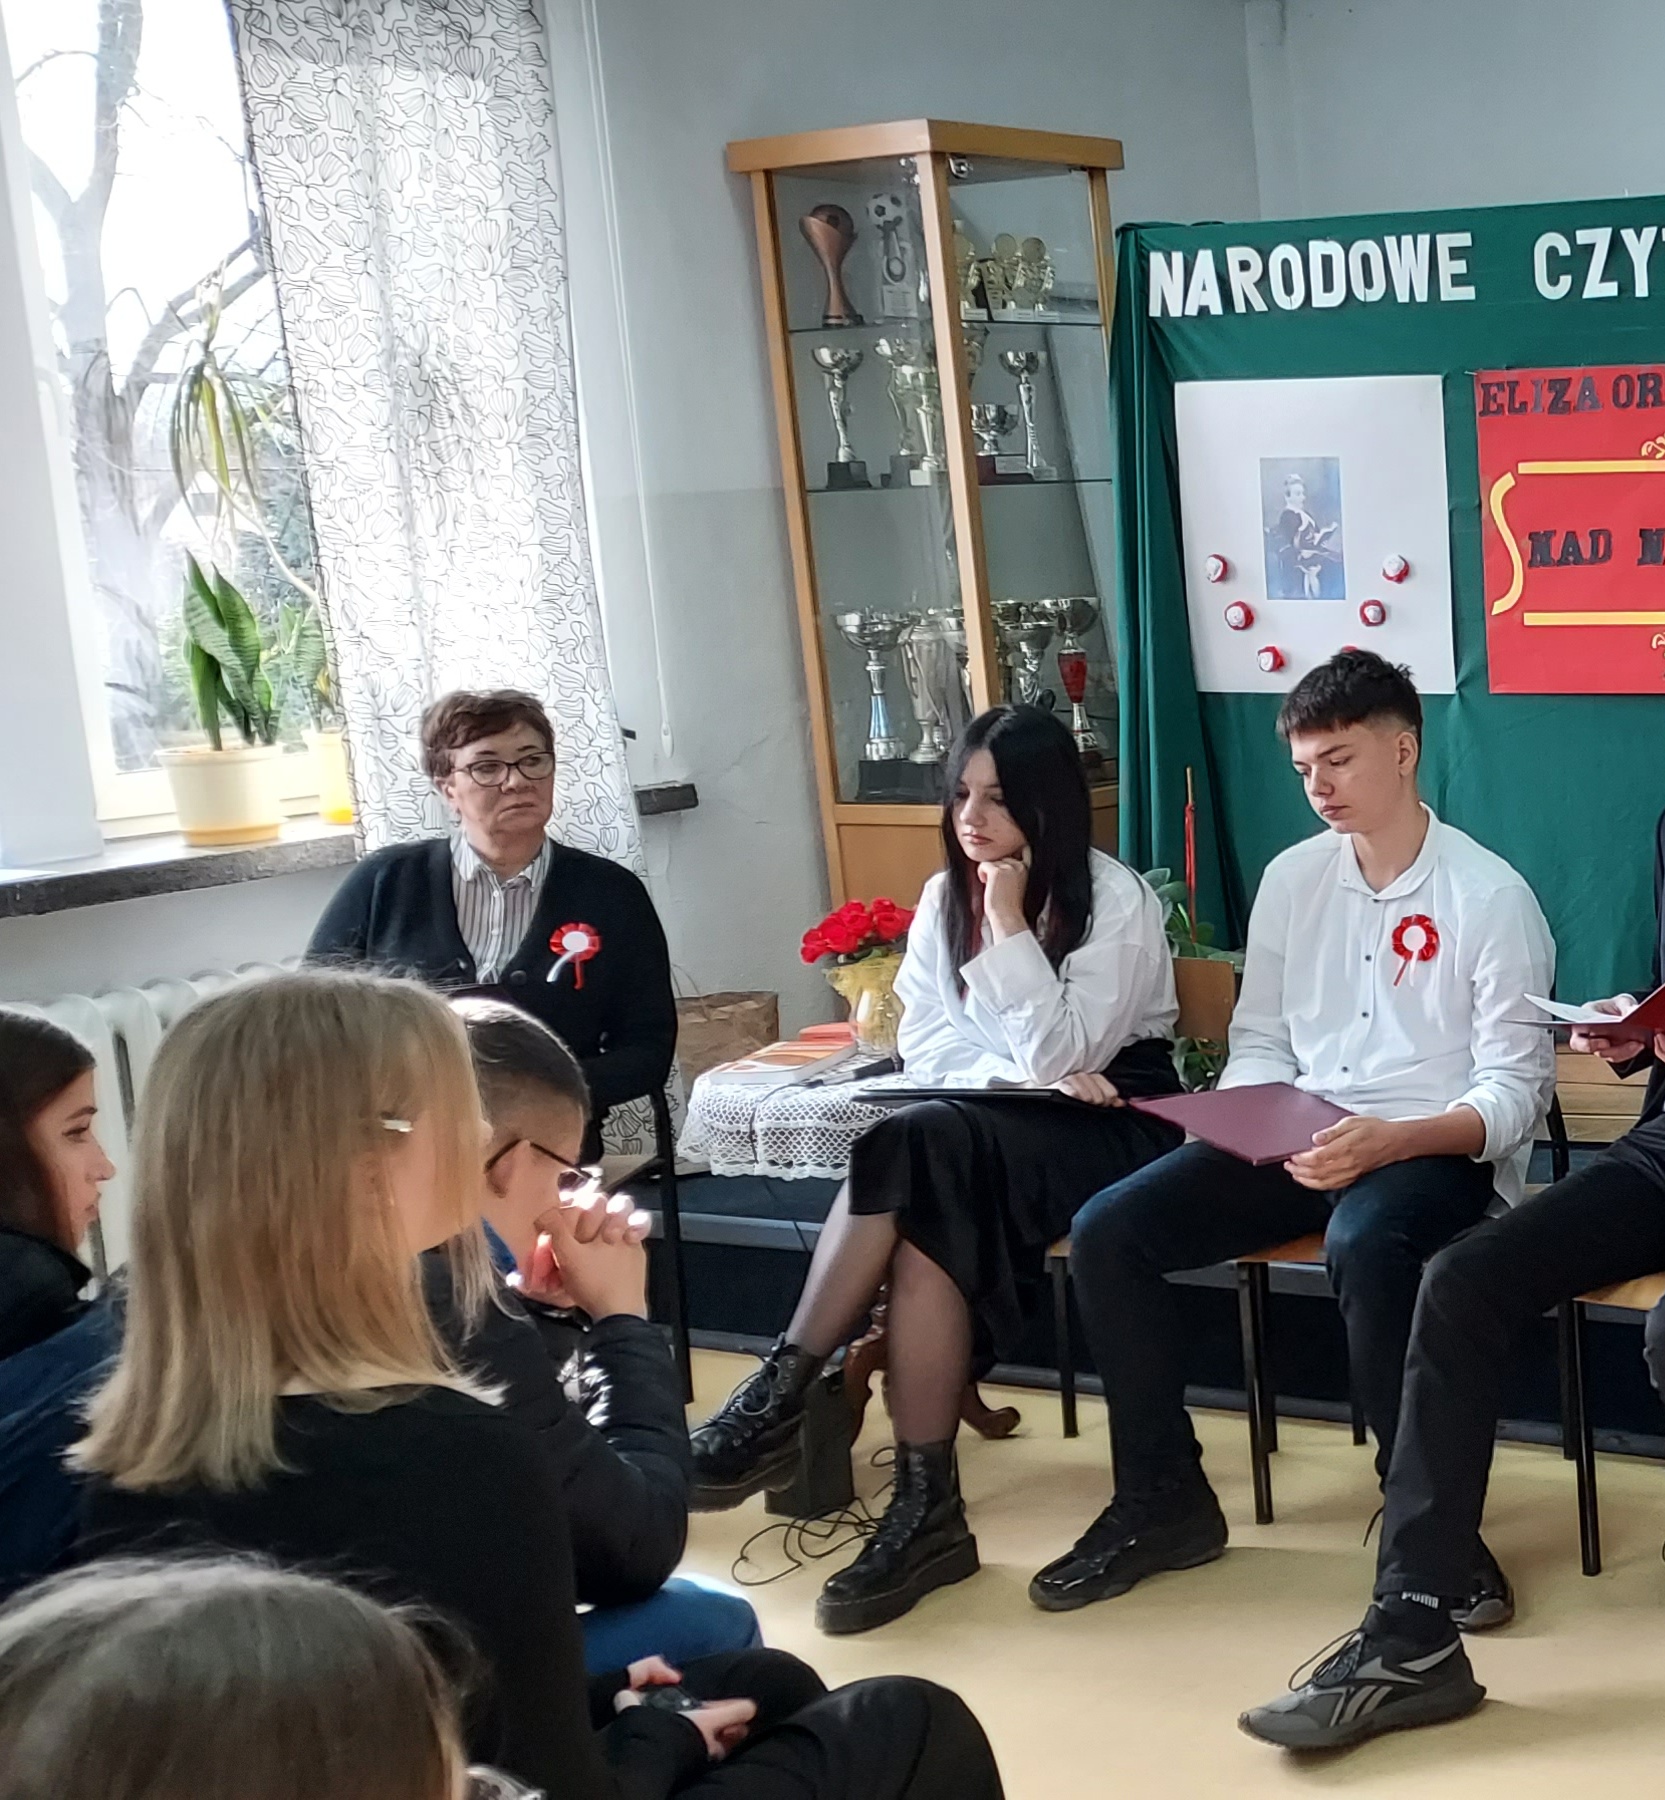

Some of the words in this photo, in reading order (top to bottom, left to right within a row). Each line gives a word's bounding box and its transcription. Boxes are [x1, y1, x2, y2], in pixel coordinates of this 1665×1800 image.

[1149, 232, 1477, 318] NARODOWE
[1478, 376, 1602, 418] ELIZA
[1527, 528, 1613, 568] NAD
